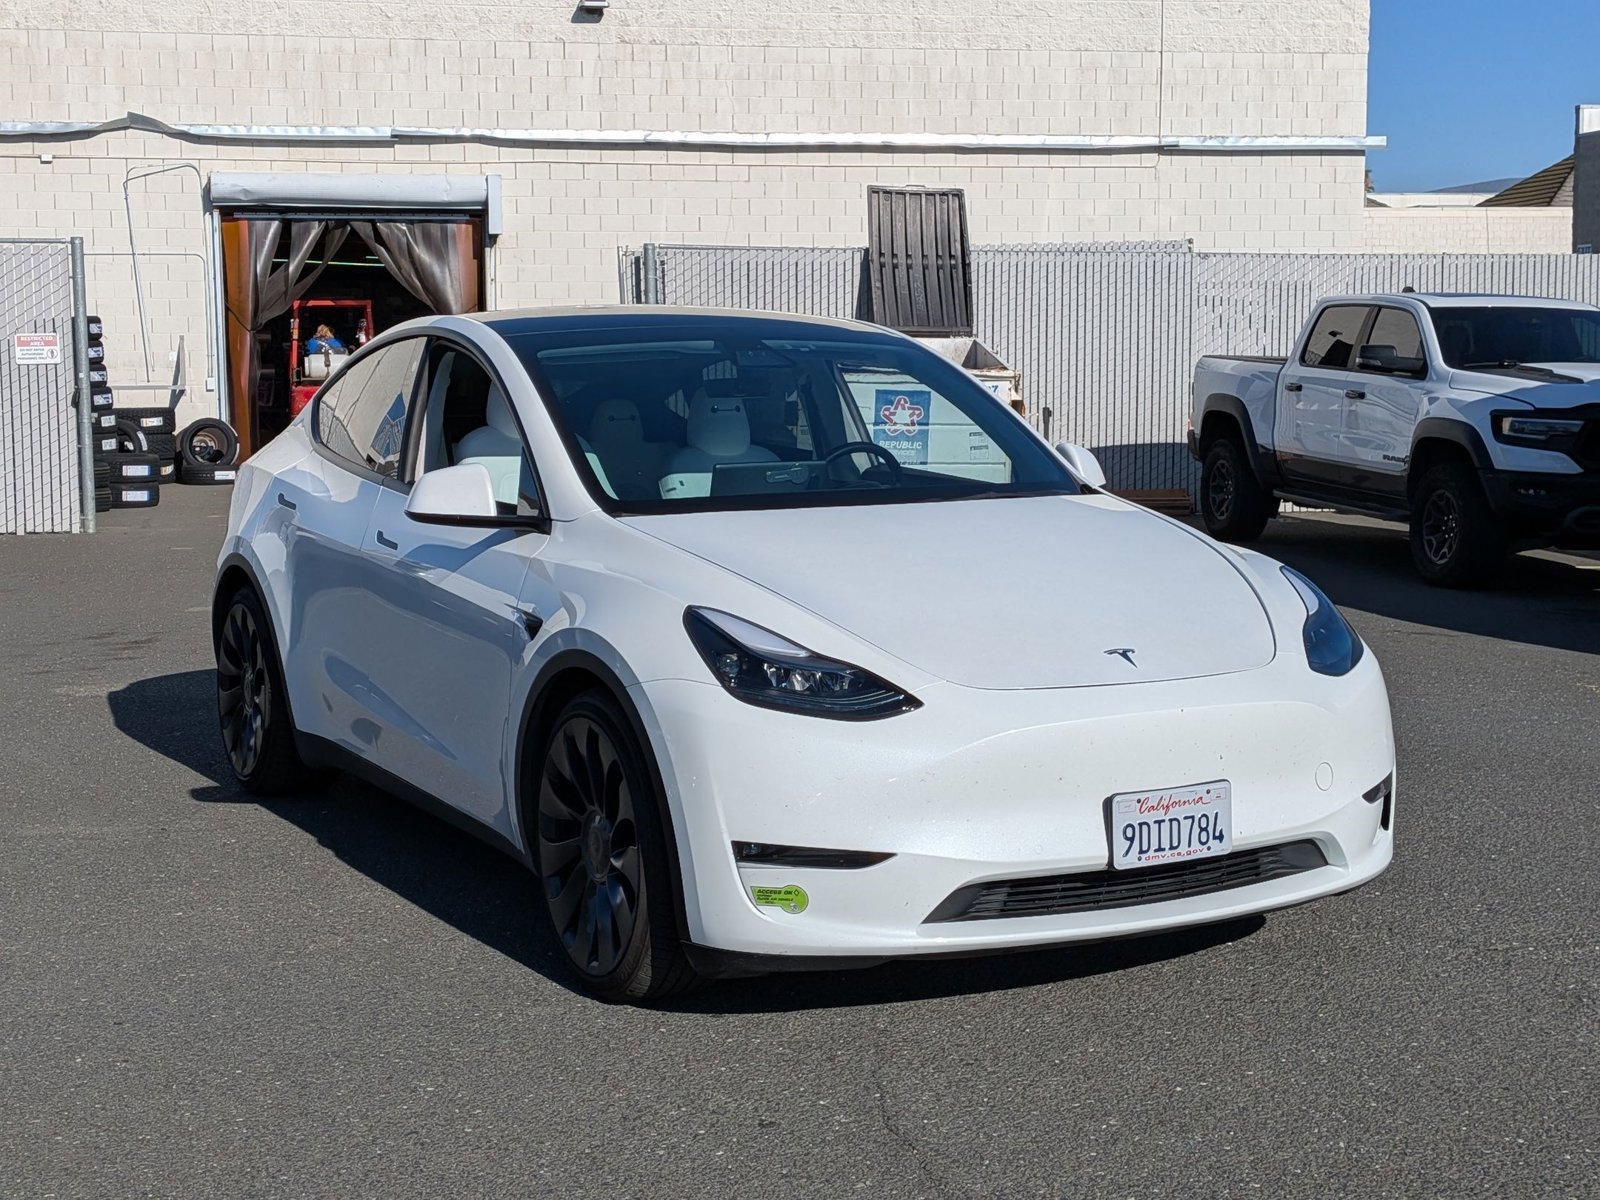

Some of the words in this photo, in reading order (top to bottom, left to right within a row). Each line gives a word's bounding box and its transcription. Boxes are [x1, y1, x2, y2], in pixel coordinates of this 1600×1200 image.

[879, 440, 923, 449] REPUBLIC
[1139, 794, 1210, 816] California
[1122, 811, 1224, 857] 9DID784
[1144, 847, 1204, 860] dmv.ca.gov
